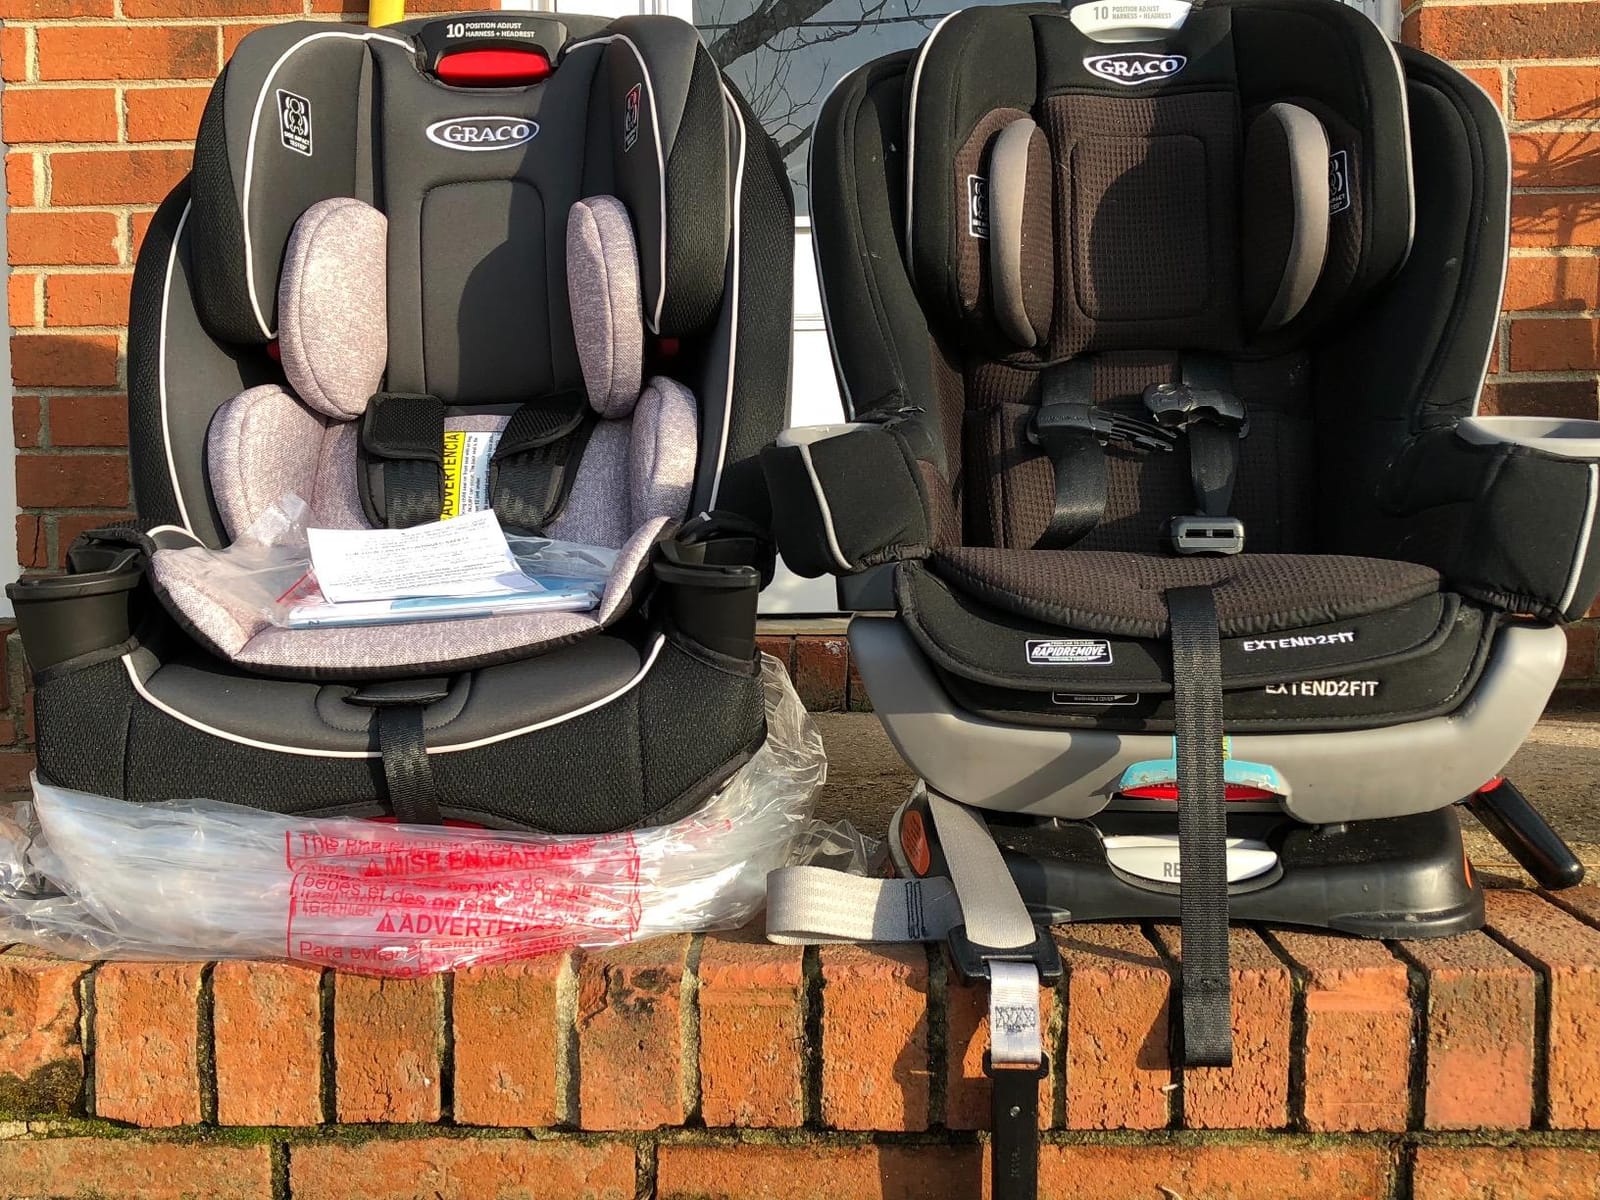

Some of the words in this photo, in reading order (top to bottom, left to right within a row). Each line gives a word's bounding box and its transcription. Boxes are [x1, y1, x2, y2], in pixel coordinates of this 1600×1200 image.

[1093, 6, 1109, 20] 10
[446, 23, 465, 38] 10
[501, 30, 536, 38] HEADREST
[1095, 59, 1178, 76] GRACO
[443, 124, 530, 142] GRACO
[441, 433, 460, 517] ADVERTENCIA
[1243, 632, 1354, 651] EXTEND2FIT
[300, 941, 344, 958] Para
